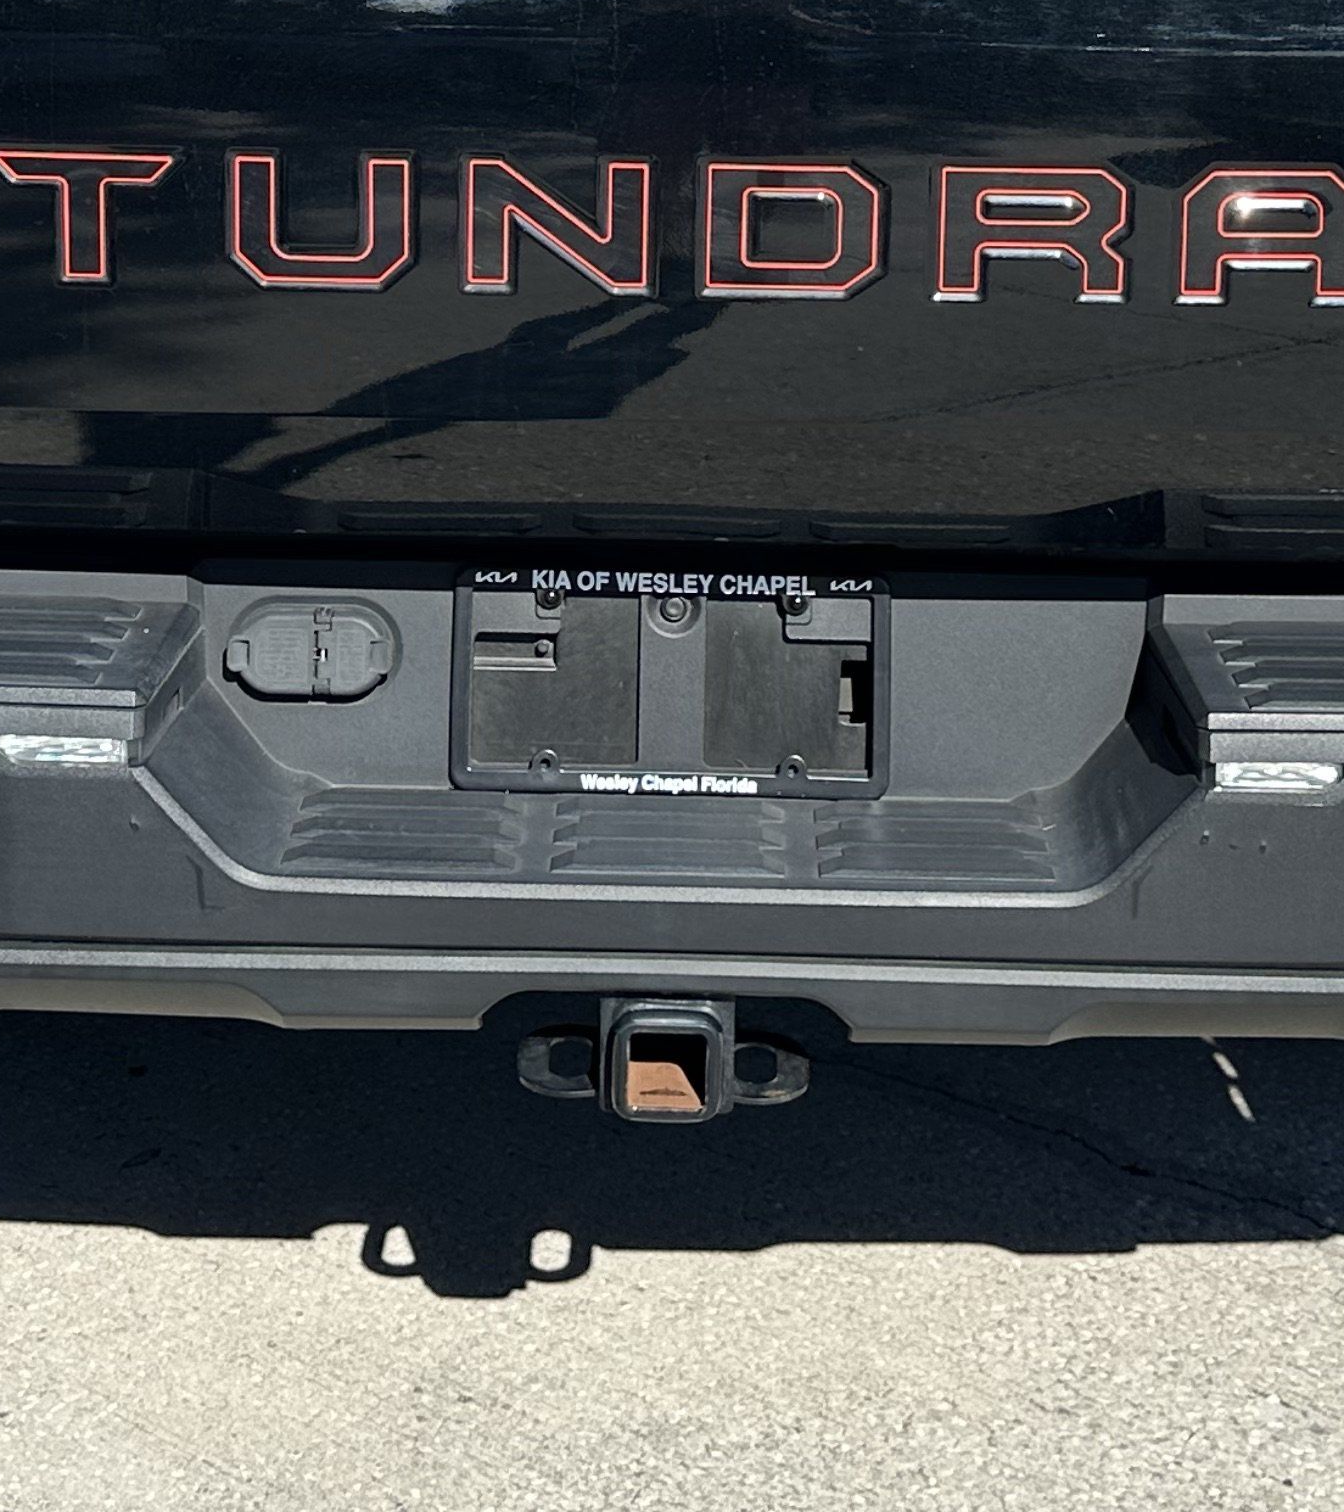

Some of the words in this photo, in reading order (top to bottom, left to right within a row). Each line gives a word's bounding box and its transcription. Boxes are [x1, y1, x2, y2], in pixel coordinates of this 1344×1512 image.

[532, 569, 571, 590] KIA
[576, 571, 610, 591] OF
[615, 572, 714, 594] WESLEY
[719, 575, 816, 596] CHAPEL
[580, 773, 638, 794] Wesley
[641, 774, 698, 794] Chapel
[700, 776, 758, 794] Florida
